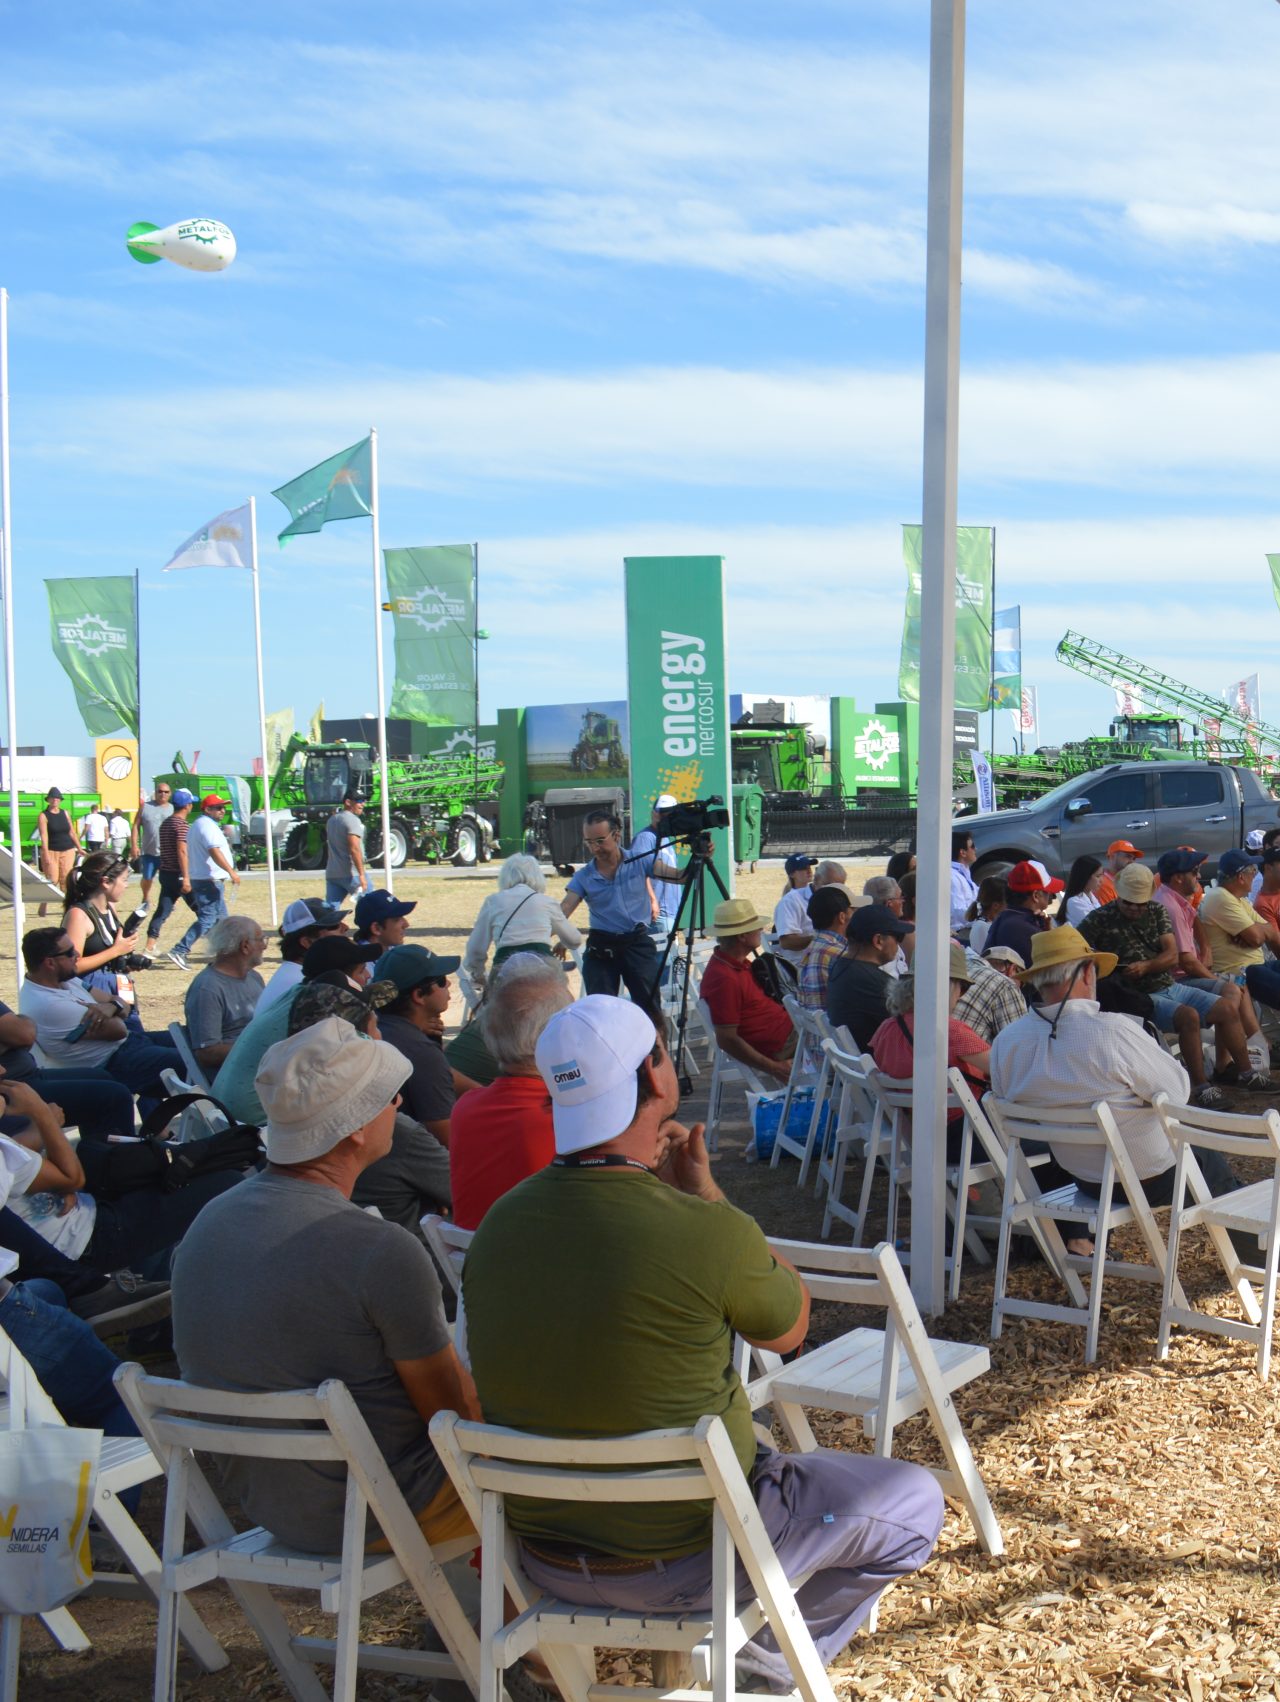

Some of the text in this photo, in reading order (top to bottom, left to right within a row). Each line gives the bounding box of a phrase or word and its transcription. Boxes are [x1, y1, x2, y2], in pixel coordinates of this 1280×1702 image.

[661, 630, 706, 757] energy
[697, 679, 715, 756] mercosur
[6, 1543, 47, 1553] SEMILLAS
[10, 1527, 59, 1542] NIDERA
